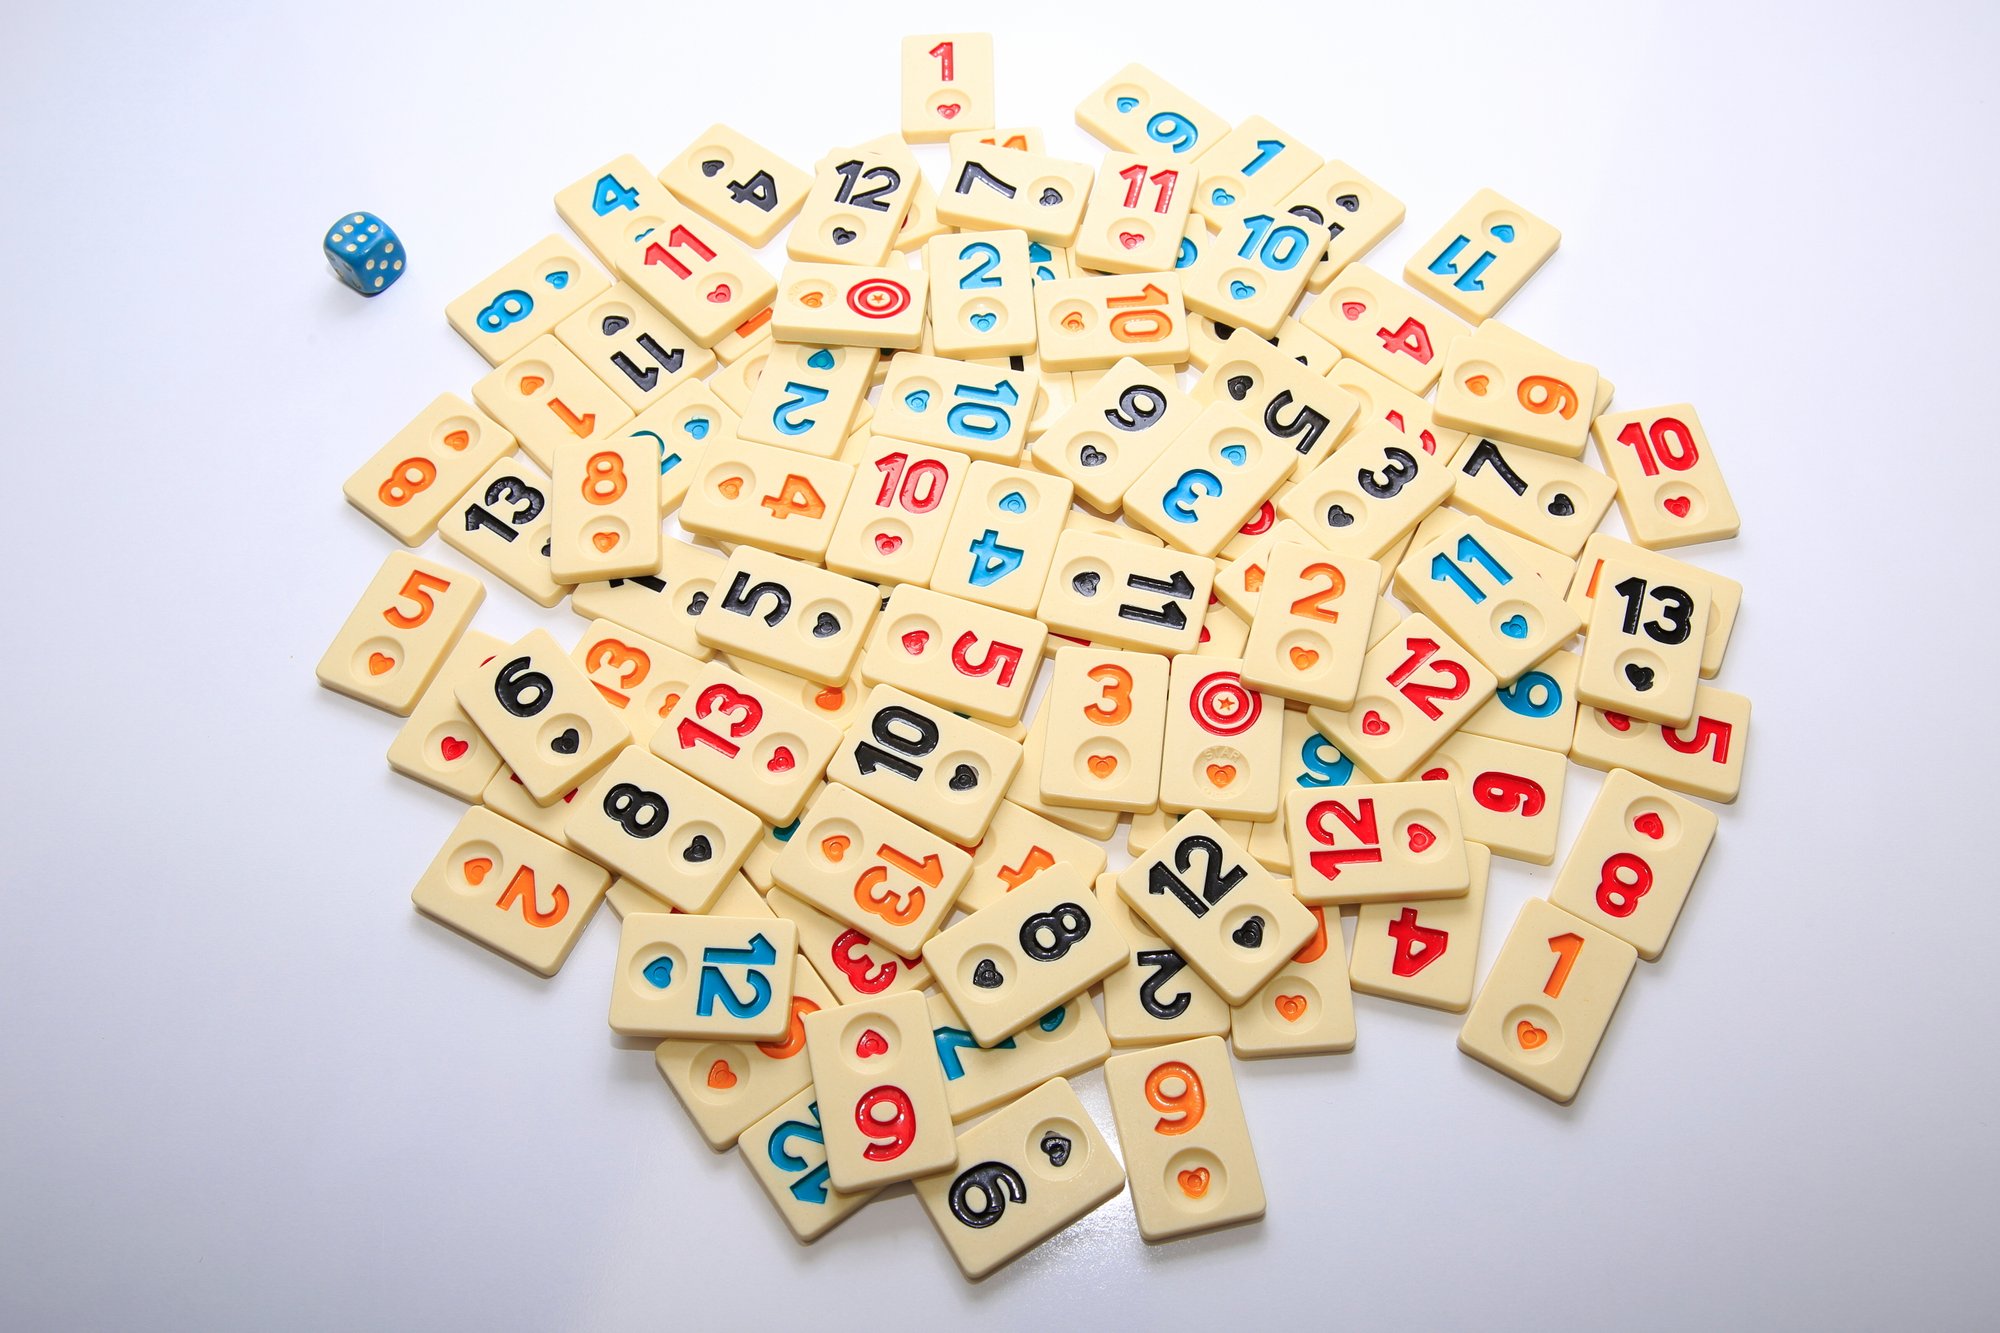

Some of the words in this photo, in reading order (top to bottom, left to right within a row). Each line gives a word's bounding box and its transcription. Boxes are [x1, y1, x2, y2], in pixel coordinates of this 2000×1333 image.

[929, 42, 953, 80] 1
[1147, 112, 1198, 152] 6
[1242, 141, 1284, 176] 1
[593, 175, 639, 216] 4
[727, 170, 777, 212] 4
[835, 160, 900, 211] 12
[956, 161, 1016, 199] 7
[1119, 164, 1178, 213] 11
[644, 224, 717, 280] 11
[960, 243, 1001, 288] 2
[1238, 215, 1308, 270] 10
[1428, 236, 1496, 291] 11
[477, 290, 533, 332] 8
[1107, 284, 1172, 341] 10
[610, 333, 684, 392] 11
[1376, 317, 1434, 365] 4
[547, 398, 595, 438] 1
[773, 383, 828, 434] 2
[947, 381, 1018, 439] 10
[1105, 385, 1167, 431] 9
[1264, 390, 1330, 455] 5
[1517, 375, 1578, 420] 6
[1358, 447, 1418, 498] 3
[1462, 440, 1528, 496] 7
[1617, 417, 1699, 476] 10
[378, 457, 436, 507] 8
[581, 451, 627, 505] 8
[761, 474, 825, 519] 4
[875, 452, 948, 513] 10
[1163, 469, 1222, 522] 3
[465, 476, 544, 542] 13
[969, 530, 1023, 586] 4
[1432, 535, 1512, 603] 11
[383, 570, 450, 629] 5
[721, 571, 791, 627] 5
[1119, 571, 1195, 630] 11
[1290, 563, 1346, 623] 2
[1615, 577, 1694, 645] 13
[495, 656, 553, 717] 6
[951, 630, 1023, 688] 5
[1386, 638, 1470, 721] 12
[677, 683, 763, 759] 13
[1084, 664, 1133, 726] 3
[854, 706, 939, 781] 10
[1661, 716, 1732, 764] 5
[603, 783, 669, 838] 8
[1473, 771, 1546, 817] 6
[1306, 798, 1382, 880] 12
[496, 865, 569, 928] 2
[854, 844, 944, 926] 13
[1149, 835, 1248, 919] 12
[1596, 853, 1653, 918] 8
[1019, 903, 1091, 962] 8
[1388, 907, 1449, 978] 4
[697, 934, 776, 1018] 12
[831, 928, 922, 995] 3
[1137, 946, 1191, 1020] 2
[1543, 933, 1584, 999] 1
[1145, 1061, 1207, 1136] 9
[948, 1161, 1027, 1229] 9
